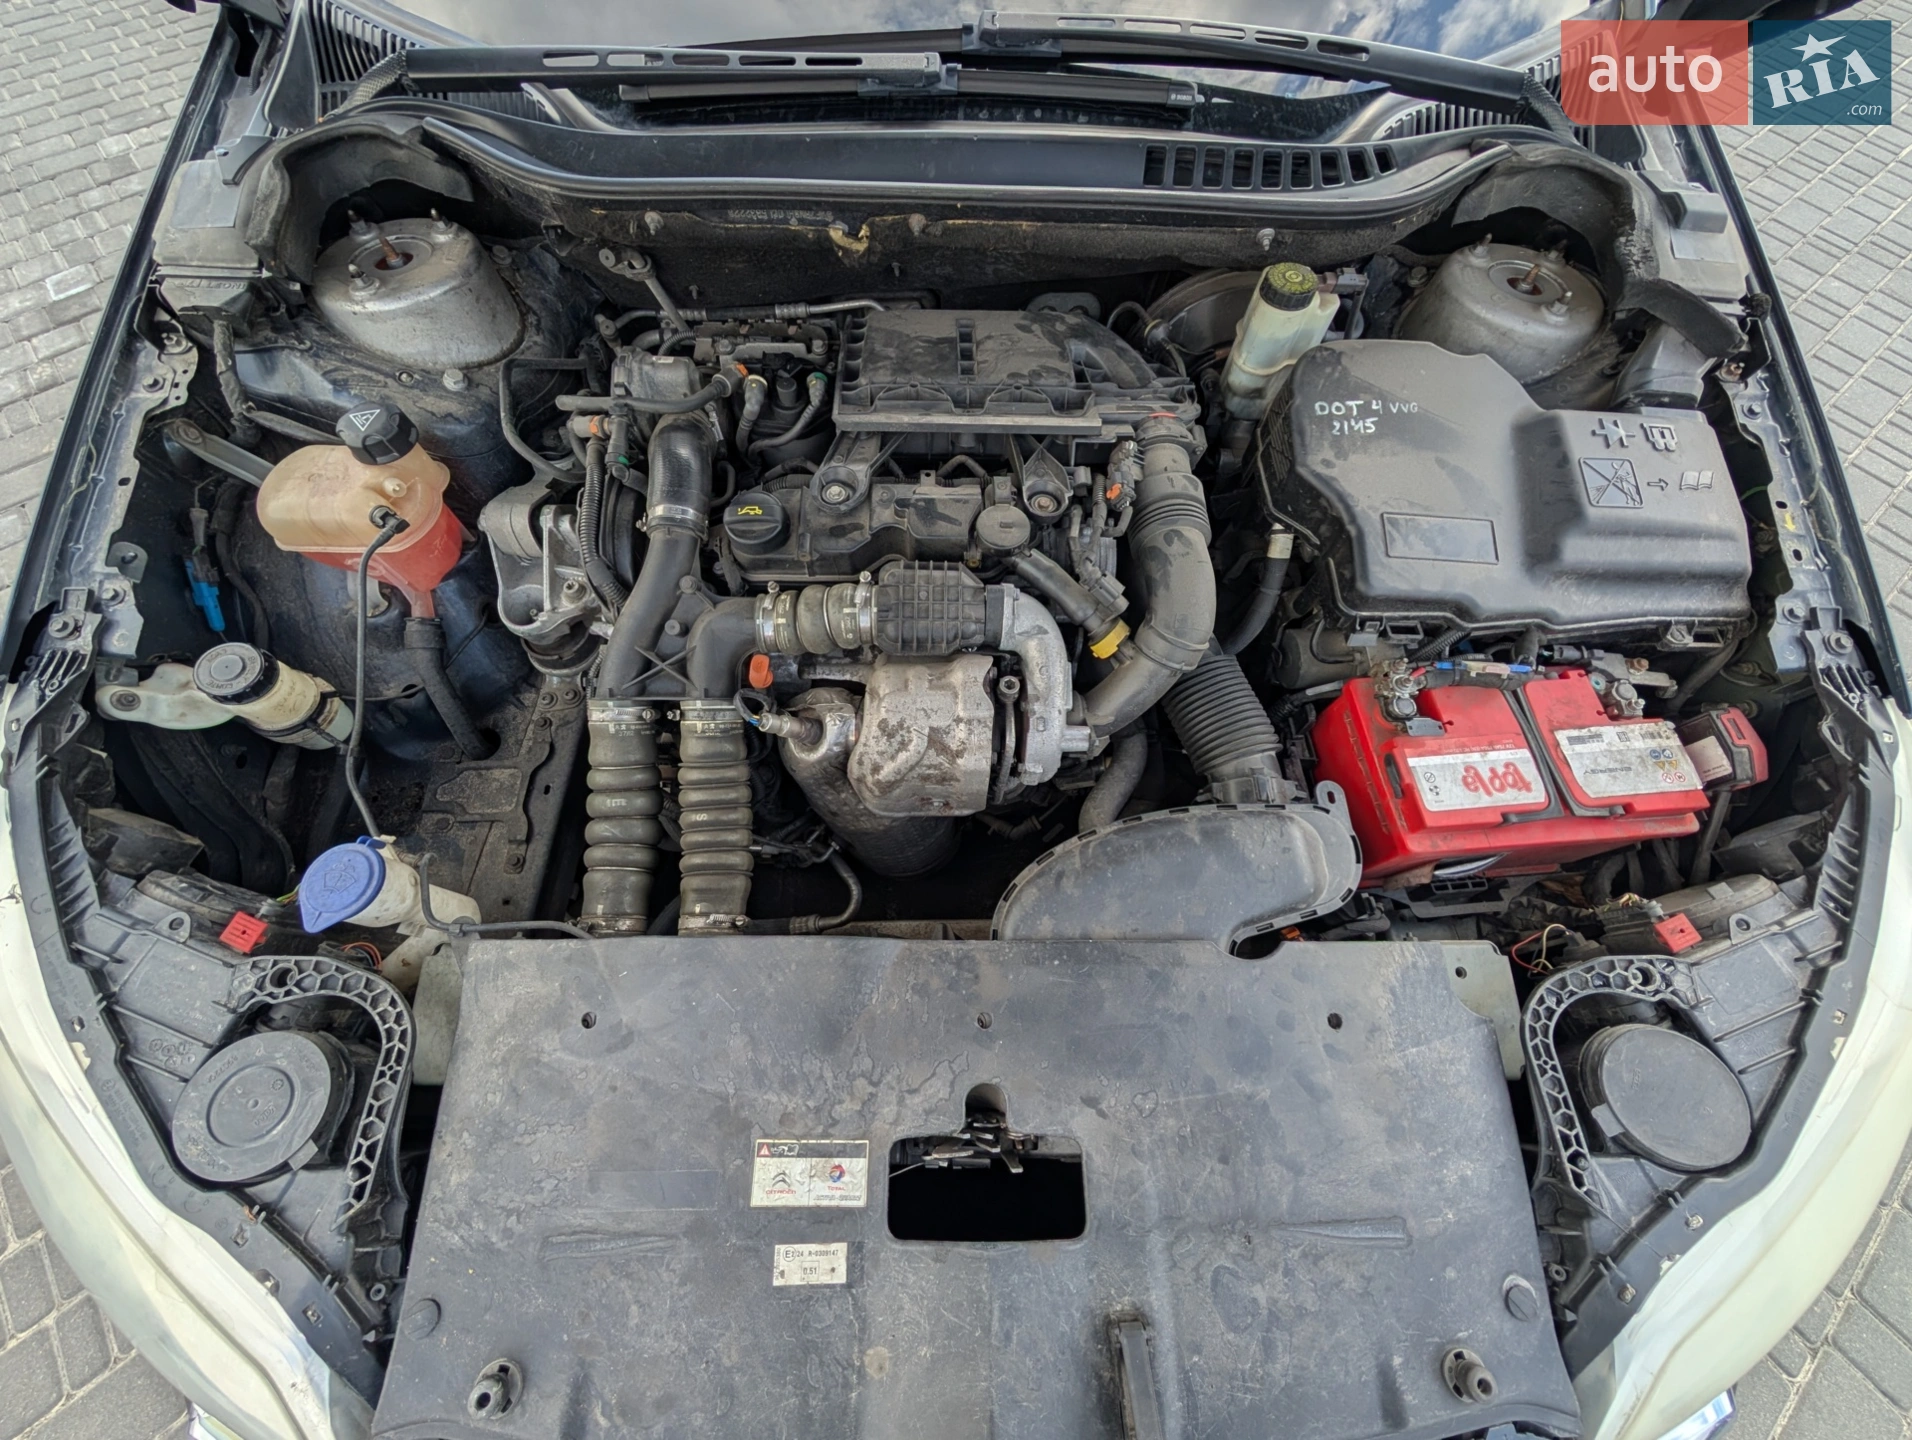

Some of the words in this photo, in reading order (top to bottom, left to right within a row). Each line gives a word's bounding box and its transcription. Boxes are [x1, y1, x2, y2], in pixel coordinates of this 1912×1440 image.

[1314, 400, 1364, 416] DOT
[1371, 399, 1383, 414] 4
[1583, 766, 1633, 775] ENERGY
[1461, 761, 1533, 797] topla
[802, 1267, 818, 1276] 0.51
